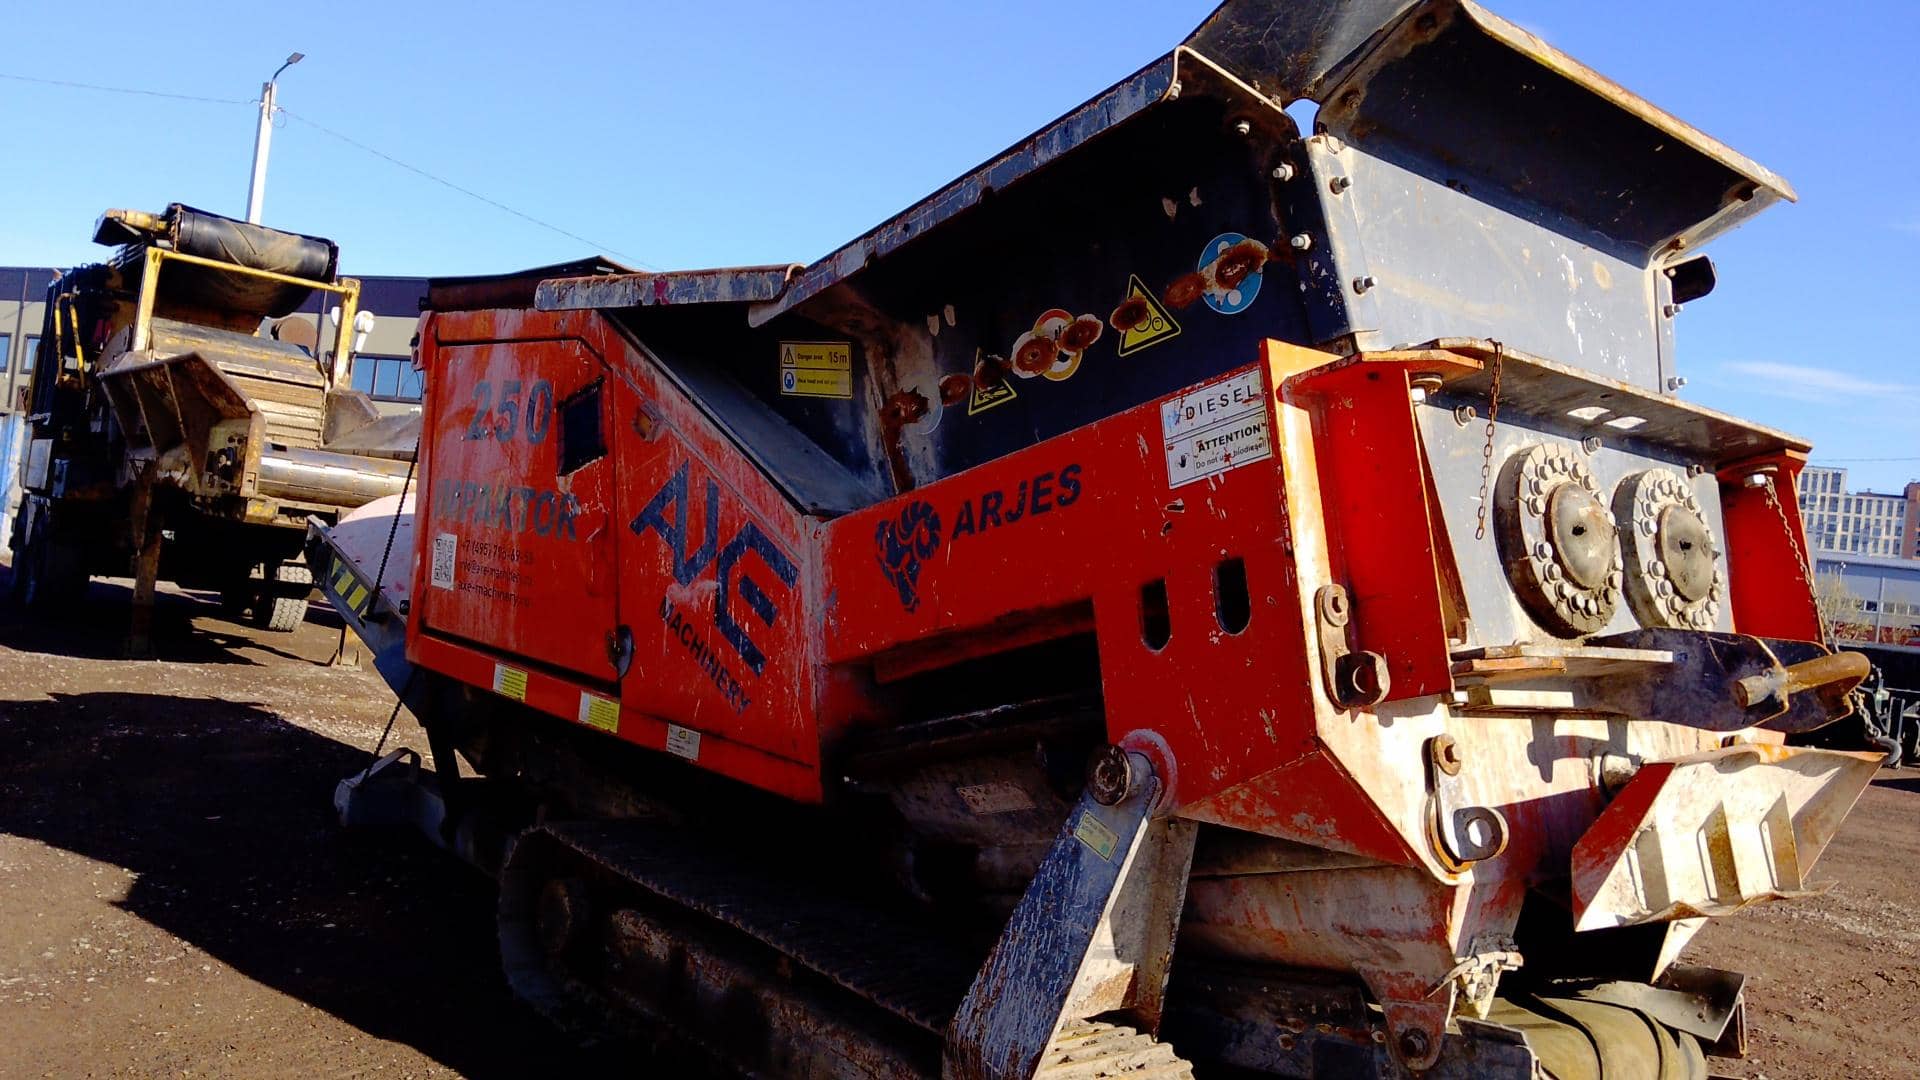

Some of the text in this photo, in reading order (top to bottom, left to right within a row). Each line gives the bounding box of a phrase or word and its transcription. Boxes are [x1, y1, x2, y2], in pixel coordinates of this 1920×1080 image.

[465, 380, 552, 445] 250
[1185, 384, 1257, 420] DIESEL
[1195, 460, 1206, 469] Do
[1206, 457, 1218, 466] not
[1198, 423, 1261, 453] ATTENTION
[951, 463, 1082, 540] ARJES
[659, 595, 751, 715] MACHINERY
